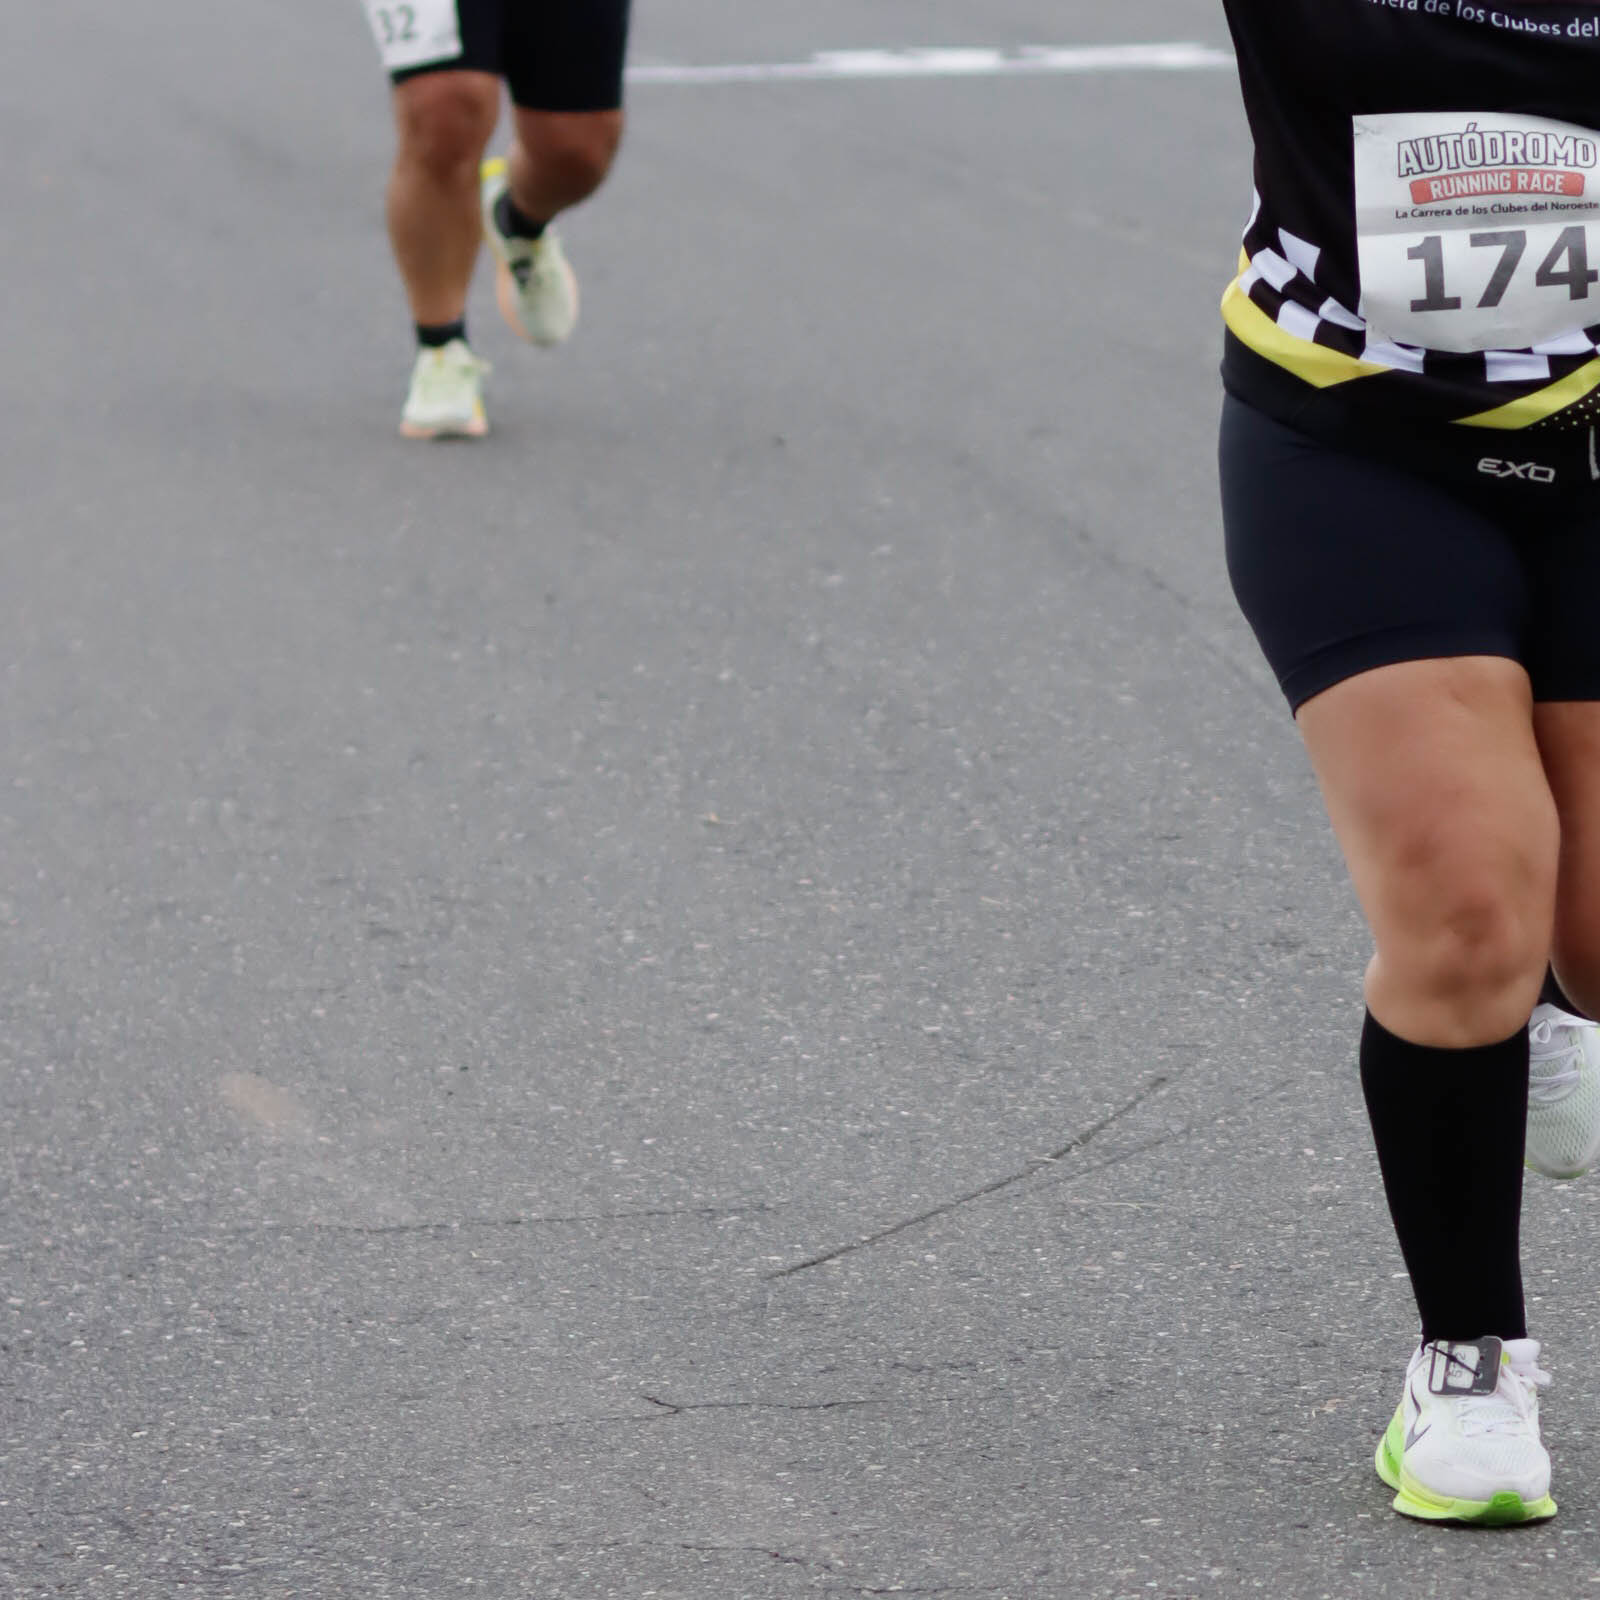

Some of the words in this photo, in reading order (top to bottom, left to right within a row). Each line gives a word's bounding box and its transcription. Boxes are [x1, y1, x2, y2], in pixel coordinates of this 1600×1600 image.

[1456, 0, 1485, 24] los
[1491, 12, 1561, 36] Clubes
[1566, 17, 1599, 38] del
[1397, 122, 1598, 178] AUTÓDROMO
[1429, 172, 1511, 201] RUNNING
[1517, 172, 1565, 194] RACE
[1395, 209, 1408, 219] La
[1411, 207, 1452, 219] Carrera
[1455, 205, 1469, 216] de
[1472, 203, 1488, 215] los
[1490, 203, 1528, 214] Clubes
[1531, 201, 1548, 212] del
[1551, 200, 1600, 211] Noroeste
[1407, 225, 1599, 313] 174
[1477, 457, 1556, 483] EXO
